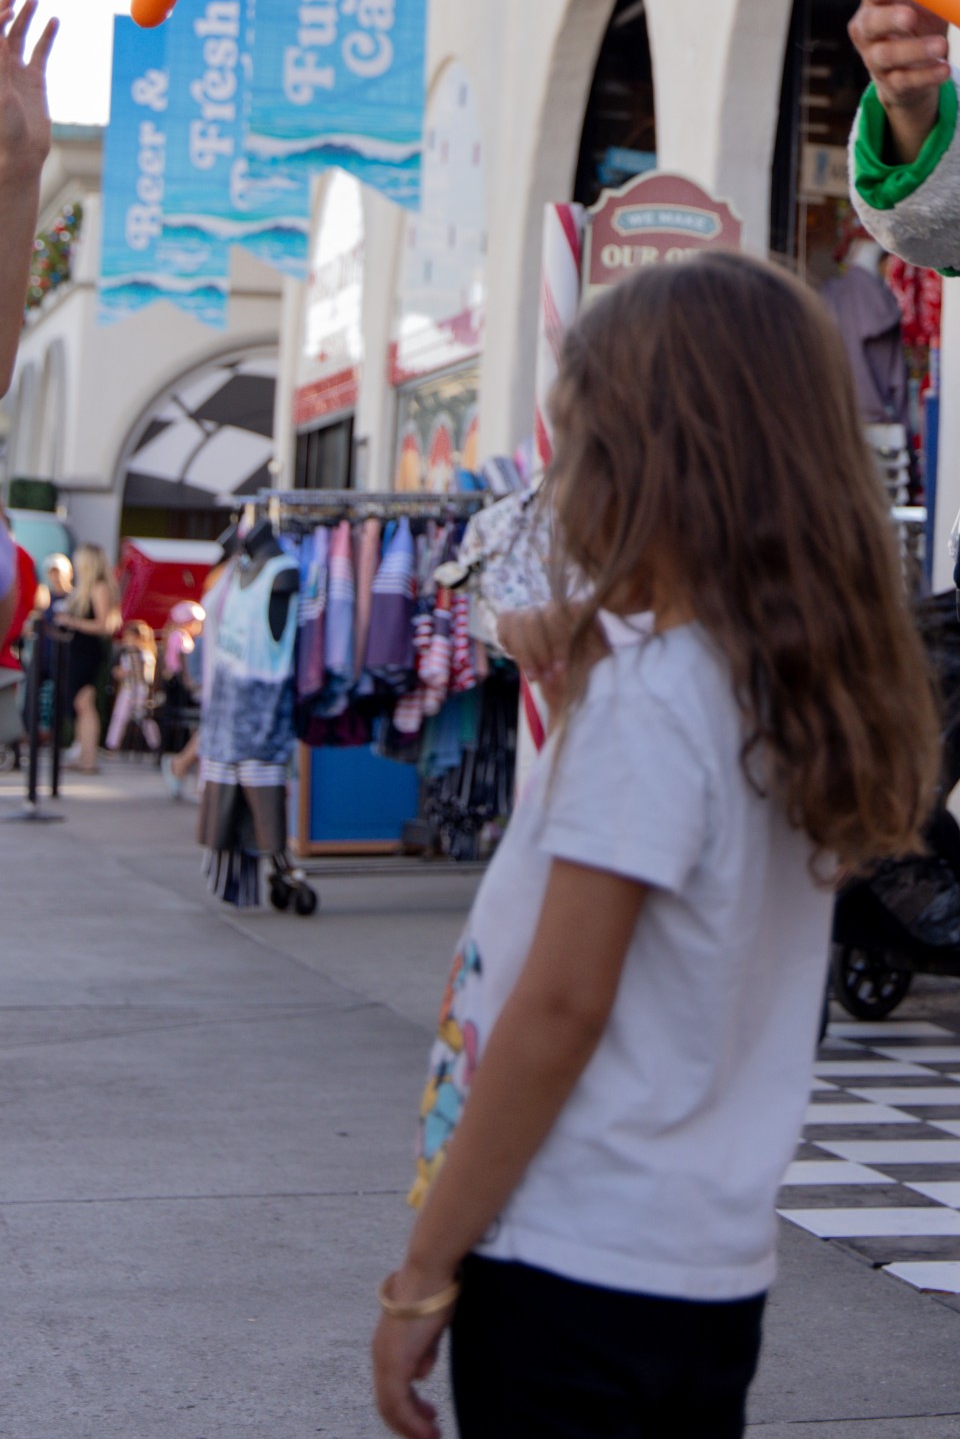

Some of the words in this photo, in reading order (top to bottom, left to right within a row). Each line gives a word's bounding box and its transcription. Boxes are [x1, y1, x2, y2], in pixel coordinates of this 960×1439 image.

[131, 68, 169, 111] &
[189, 0, 241, 170] Fresh
[125, 120, 166, 251] Beer
[628, 212, 655, 226] WE
[601, 243, 659, 268] OUR
